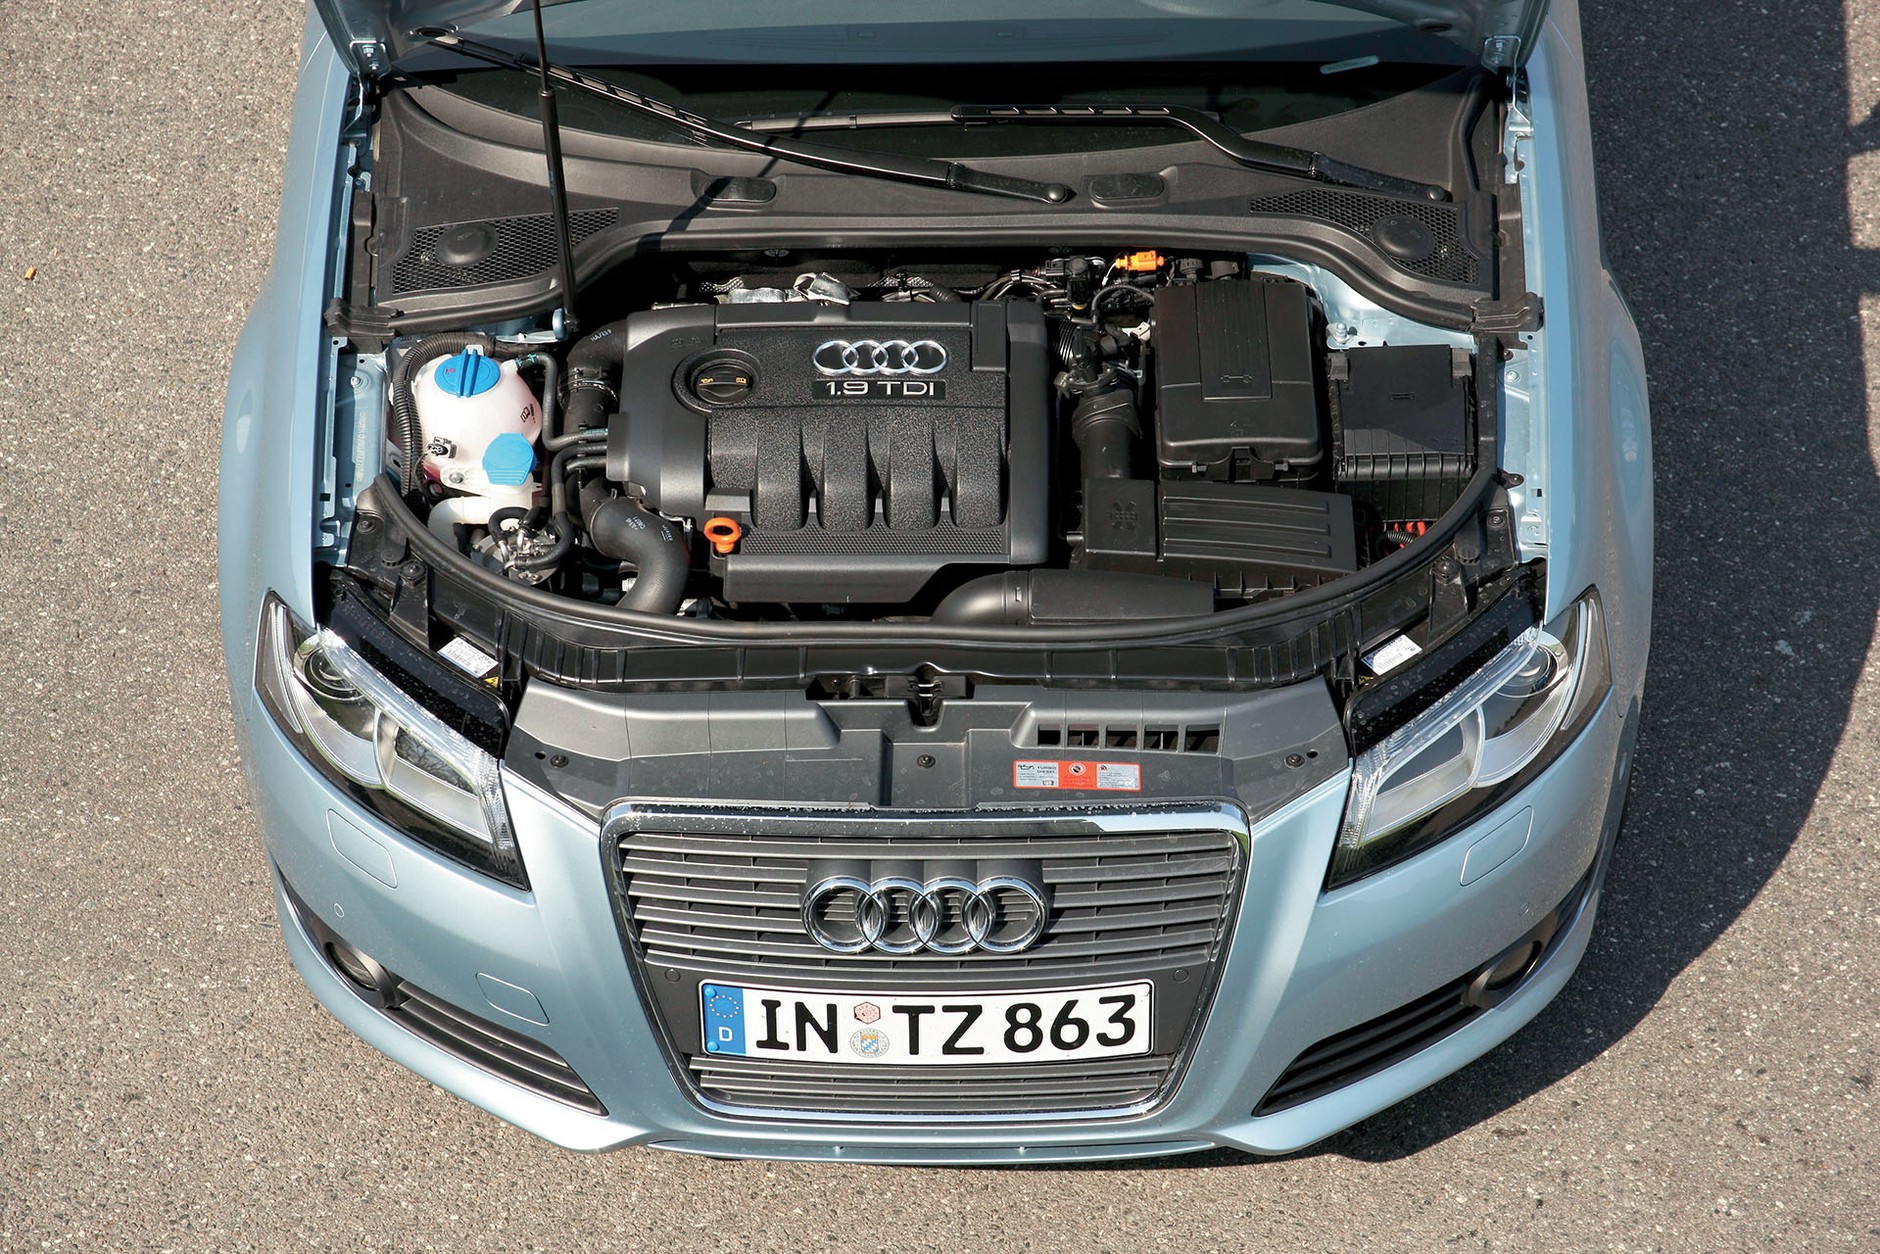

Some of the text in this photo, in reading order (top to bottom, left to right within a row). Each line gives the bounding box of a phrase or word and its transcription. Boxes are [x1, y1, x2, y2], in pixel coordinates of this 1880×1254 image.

[826, 381, 935, 396] 1.9 TDI
[757, 1000, 838, 1053] IN
[892, 1005, 984, 1055] TZ
[1003, 994, 1135, 1053] 863
[718, 1026, 733, 1042] D
